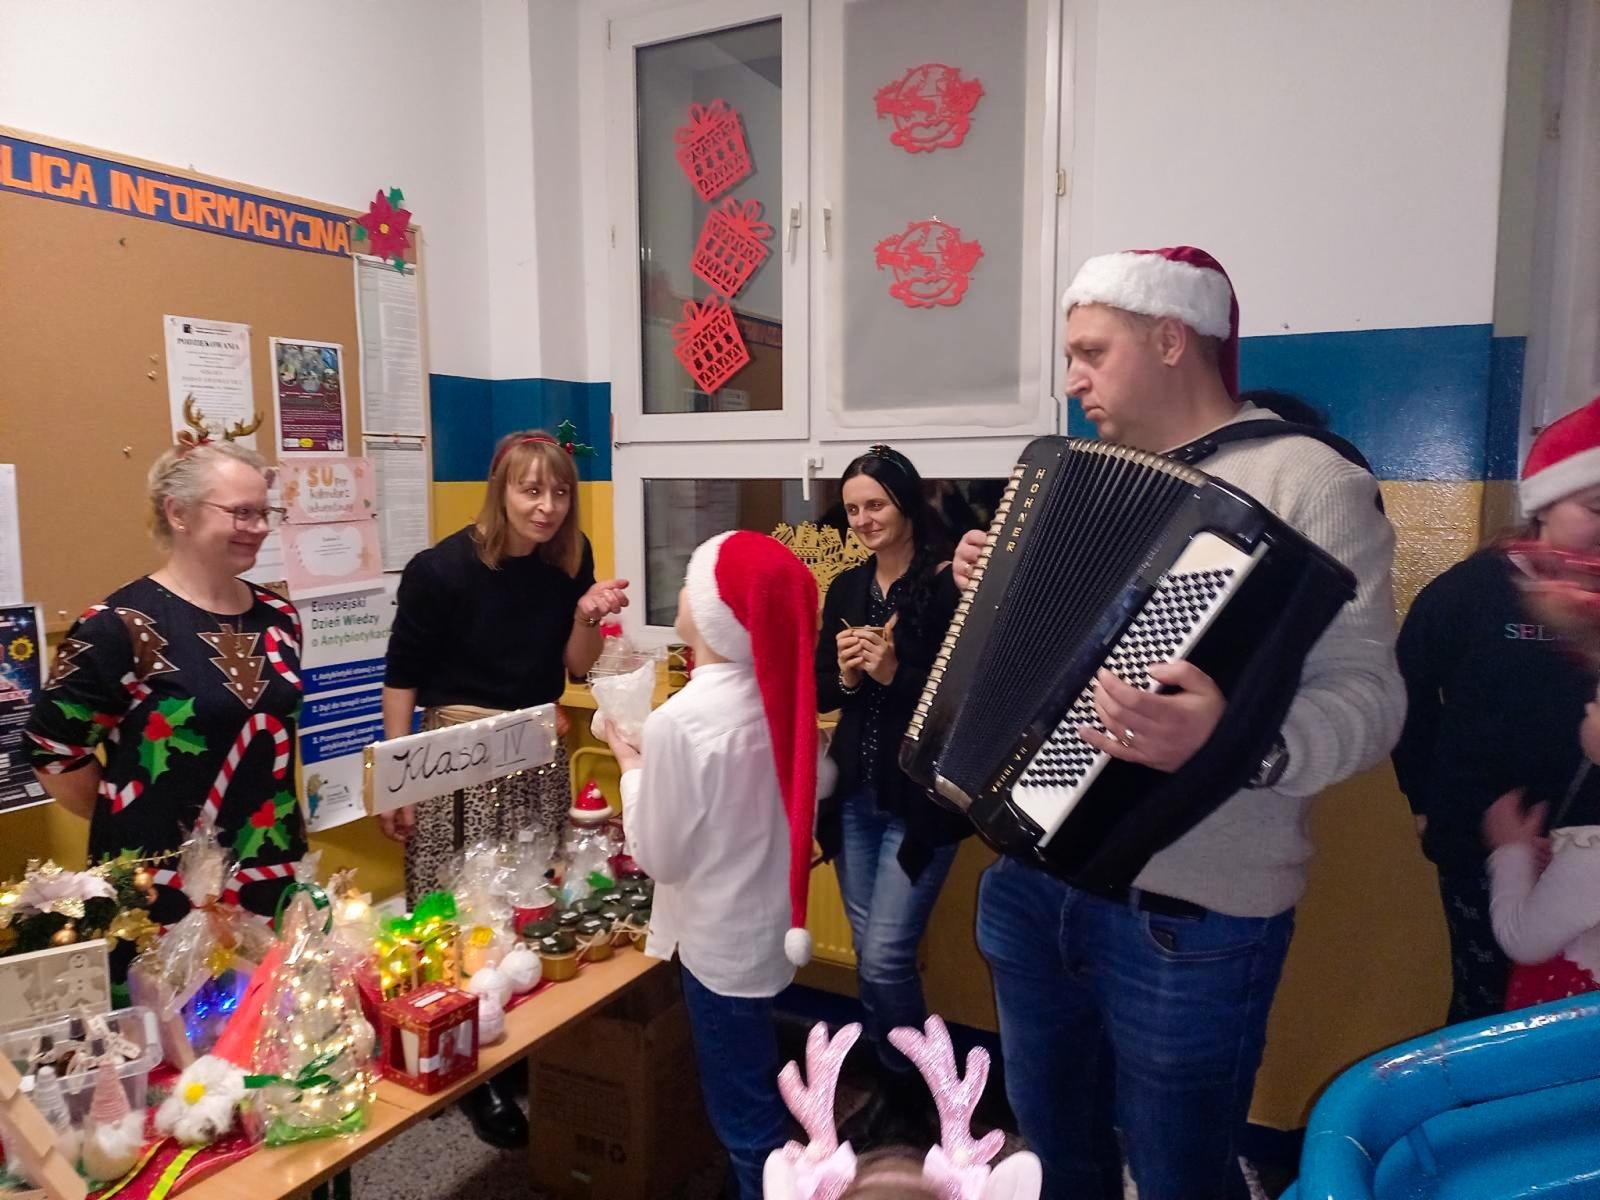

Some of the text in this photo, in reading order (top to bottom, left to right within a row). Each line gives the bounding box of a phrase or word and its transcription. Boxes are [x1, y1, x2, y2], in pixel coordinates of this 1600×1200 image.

[0, 144, 351, 255] LICA INFORMACYJNA
[1006, 468, 1047, 552] HOHNER
[312, 598, 367, 613] Europejski
[312, 613, 380, 630] Dzień Wiedzy
[1504, 623, 1559, 640] SEL
[311, 638, 319, 647] o
[388, 718, 534, 793] Klasa IV
